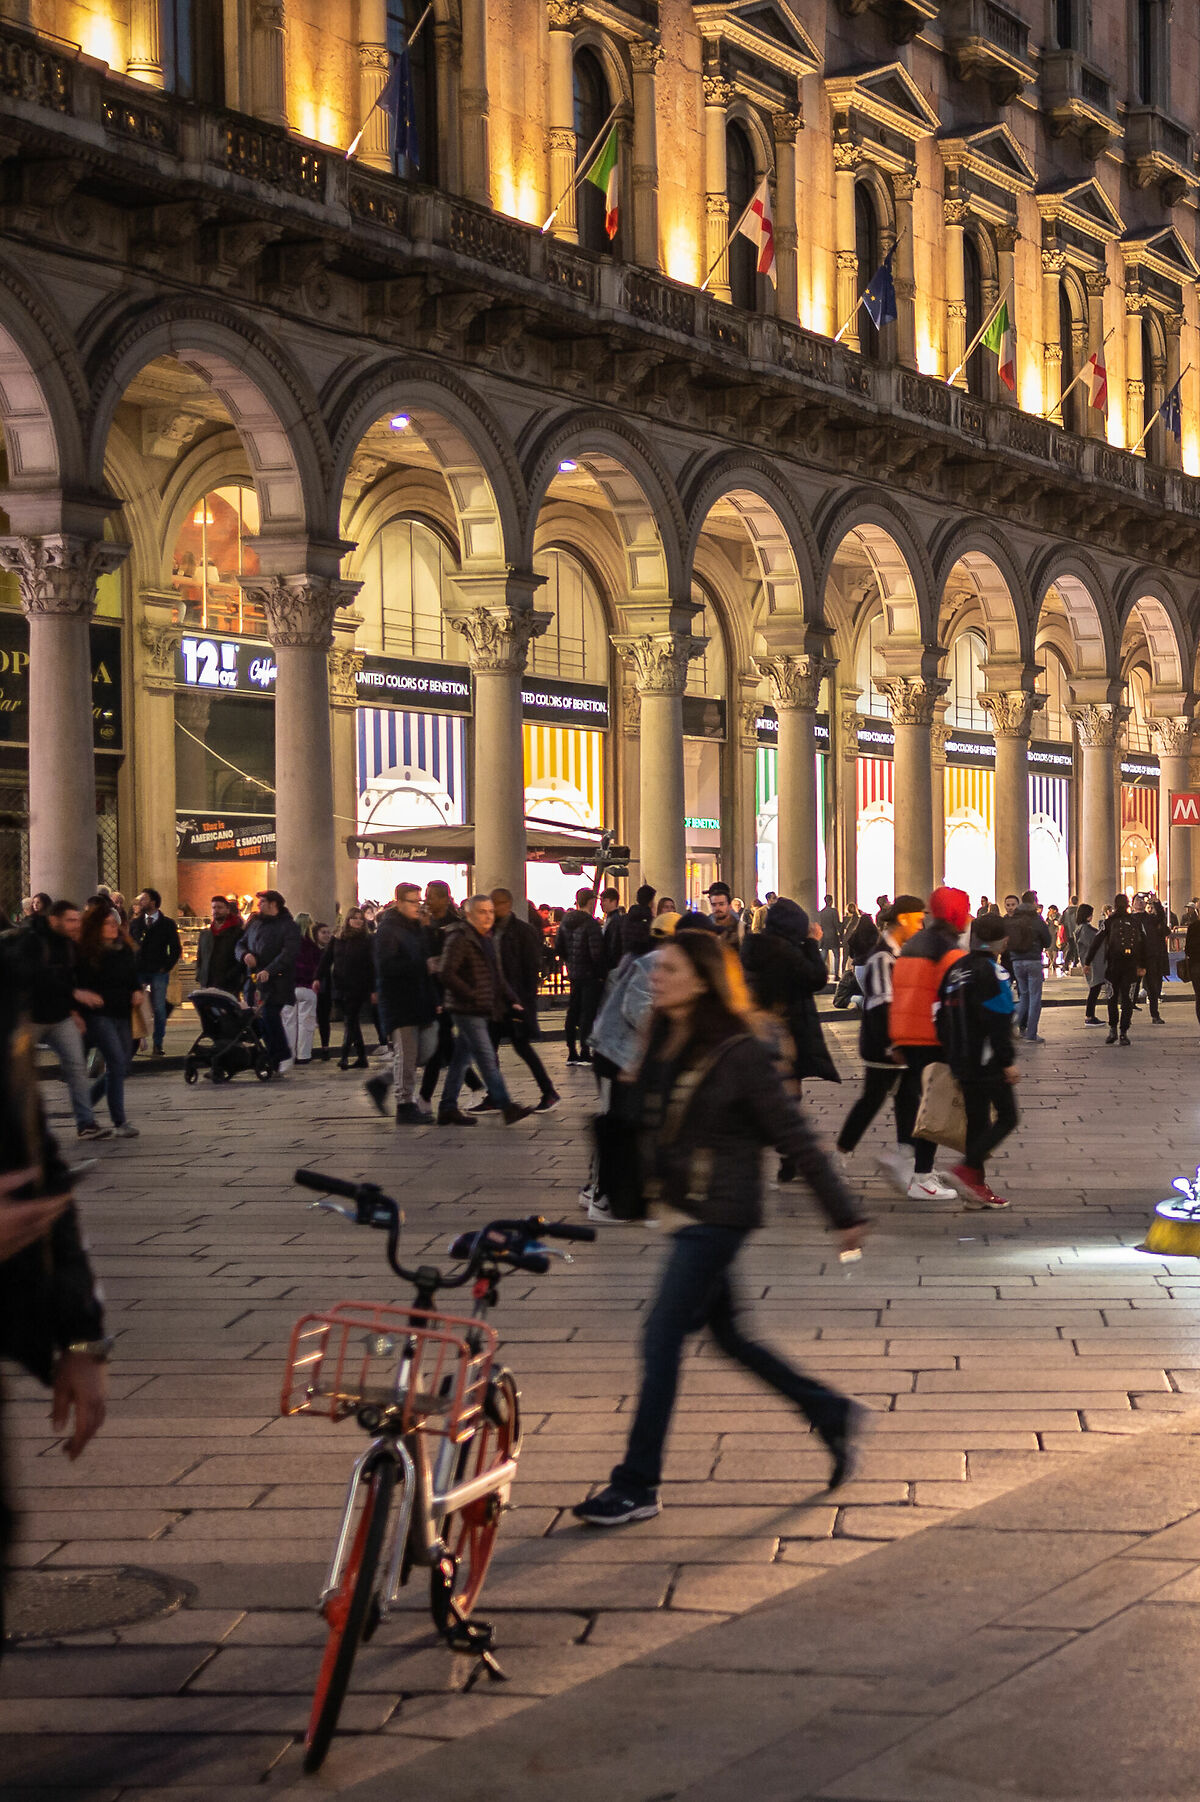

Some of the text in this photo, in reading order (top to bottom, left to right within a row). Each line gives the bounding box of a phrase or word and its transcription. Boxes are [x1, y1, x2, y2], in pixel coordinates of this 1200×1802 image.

[355, 672, 470, 696] UNITED COLORS OF BENETTON.
[535, 694, 563, 708] COLORS
[563, 697, 573, 709] OF
[1173, 799, 1200, 820] M
[190, 830, 234, 844] AMERICANO
[215, 840, 236, 851] JUICE
[236, 838, 242, 848] &
[238, 846, 262, 857] SWEET
